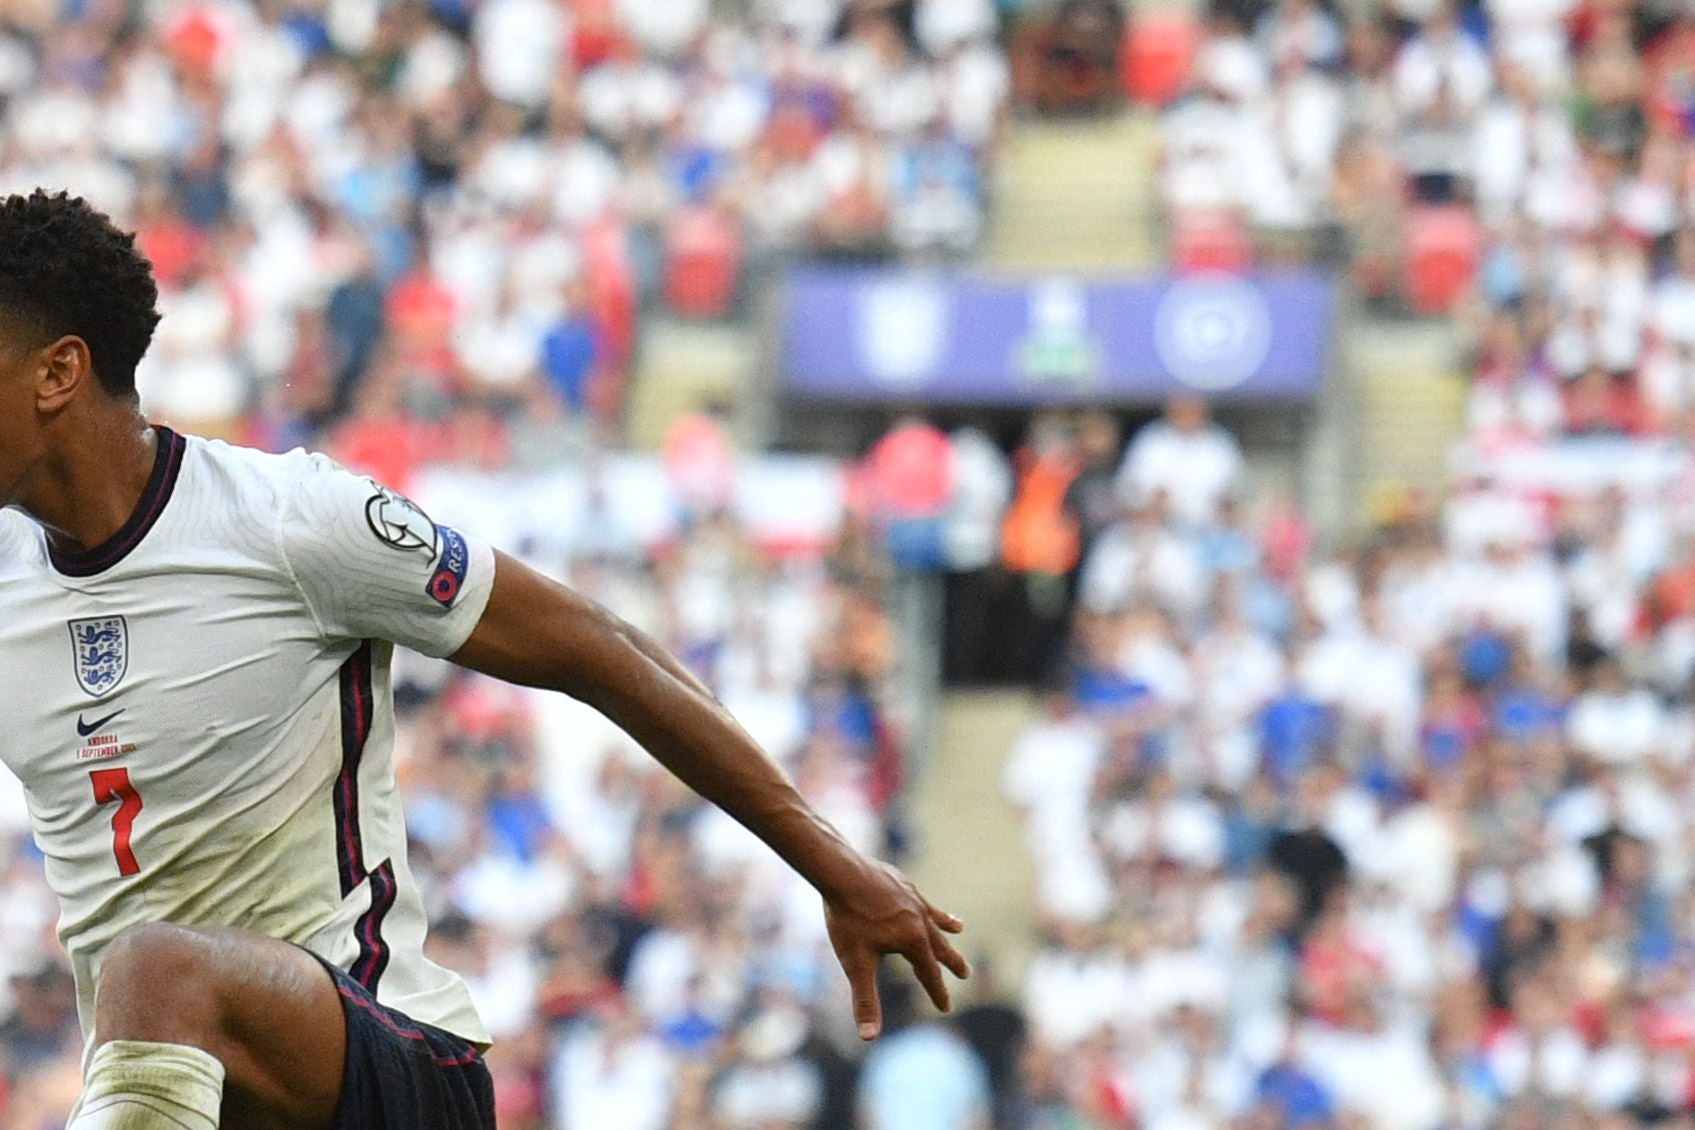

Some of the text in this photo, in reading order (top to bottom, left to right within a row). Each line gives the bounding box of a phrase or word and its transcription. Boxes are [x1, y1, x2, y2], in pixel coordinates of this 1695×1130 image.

[87, 734, 118, 746] ANDORRA
[81, 746, 119, 758] SEPTEMBER
[89, 767, 143, 877] 7
